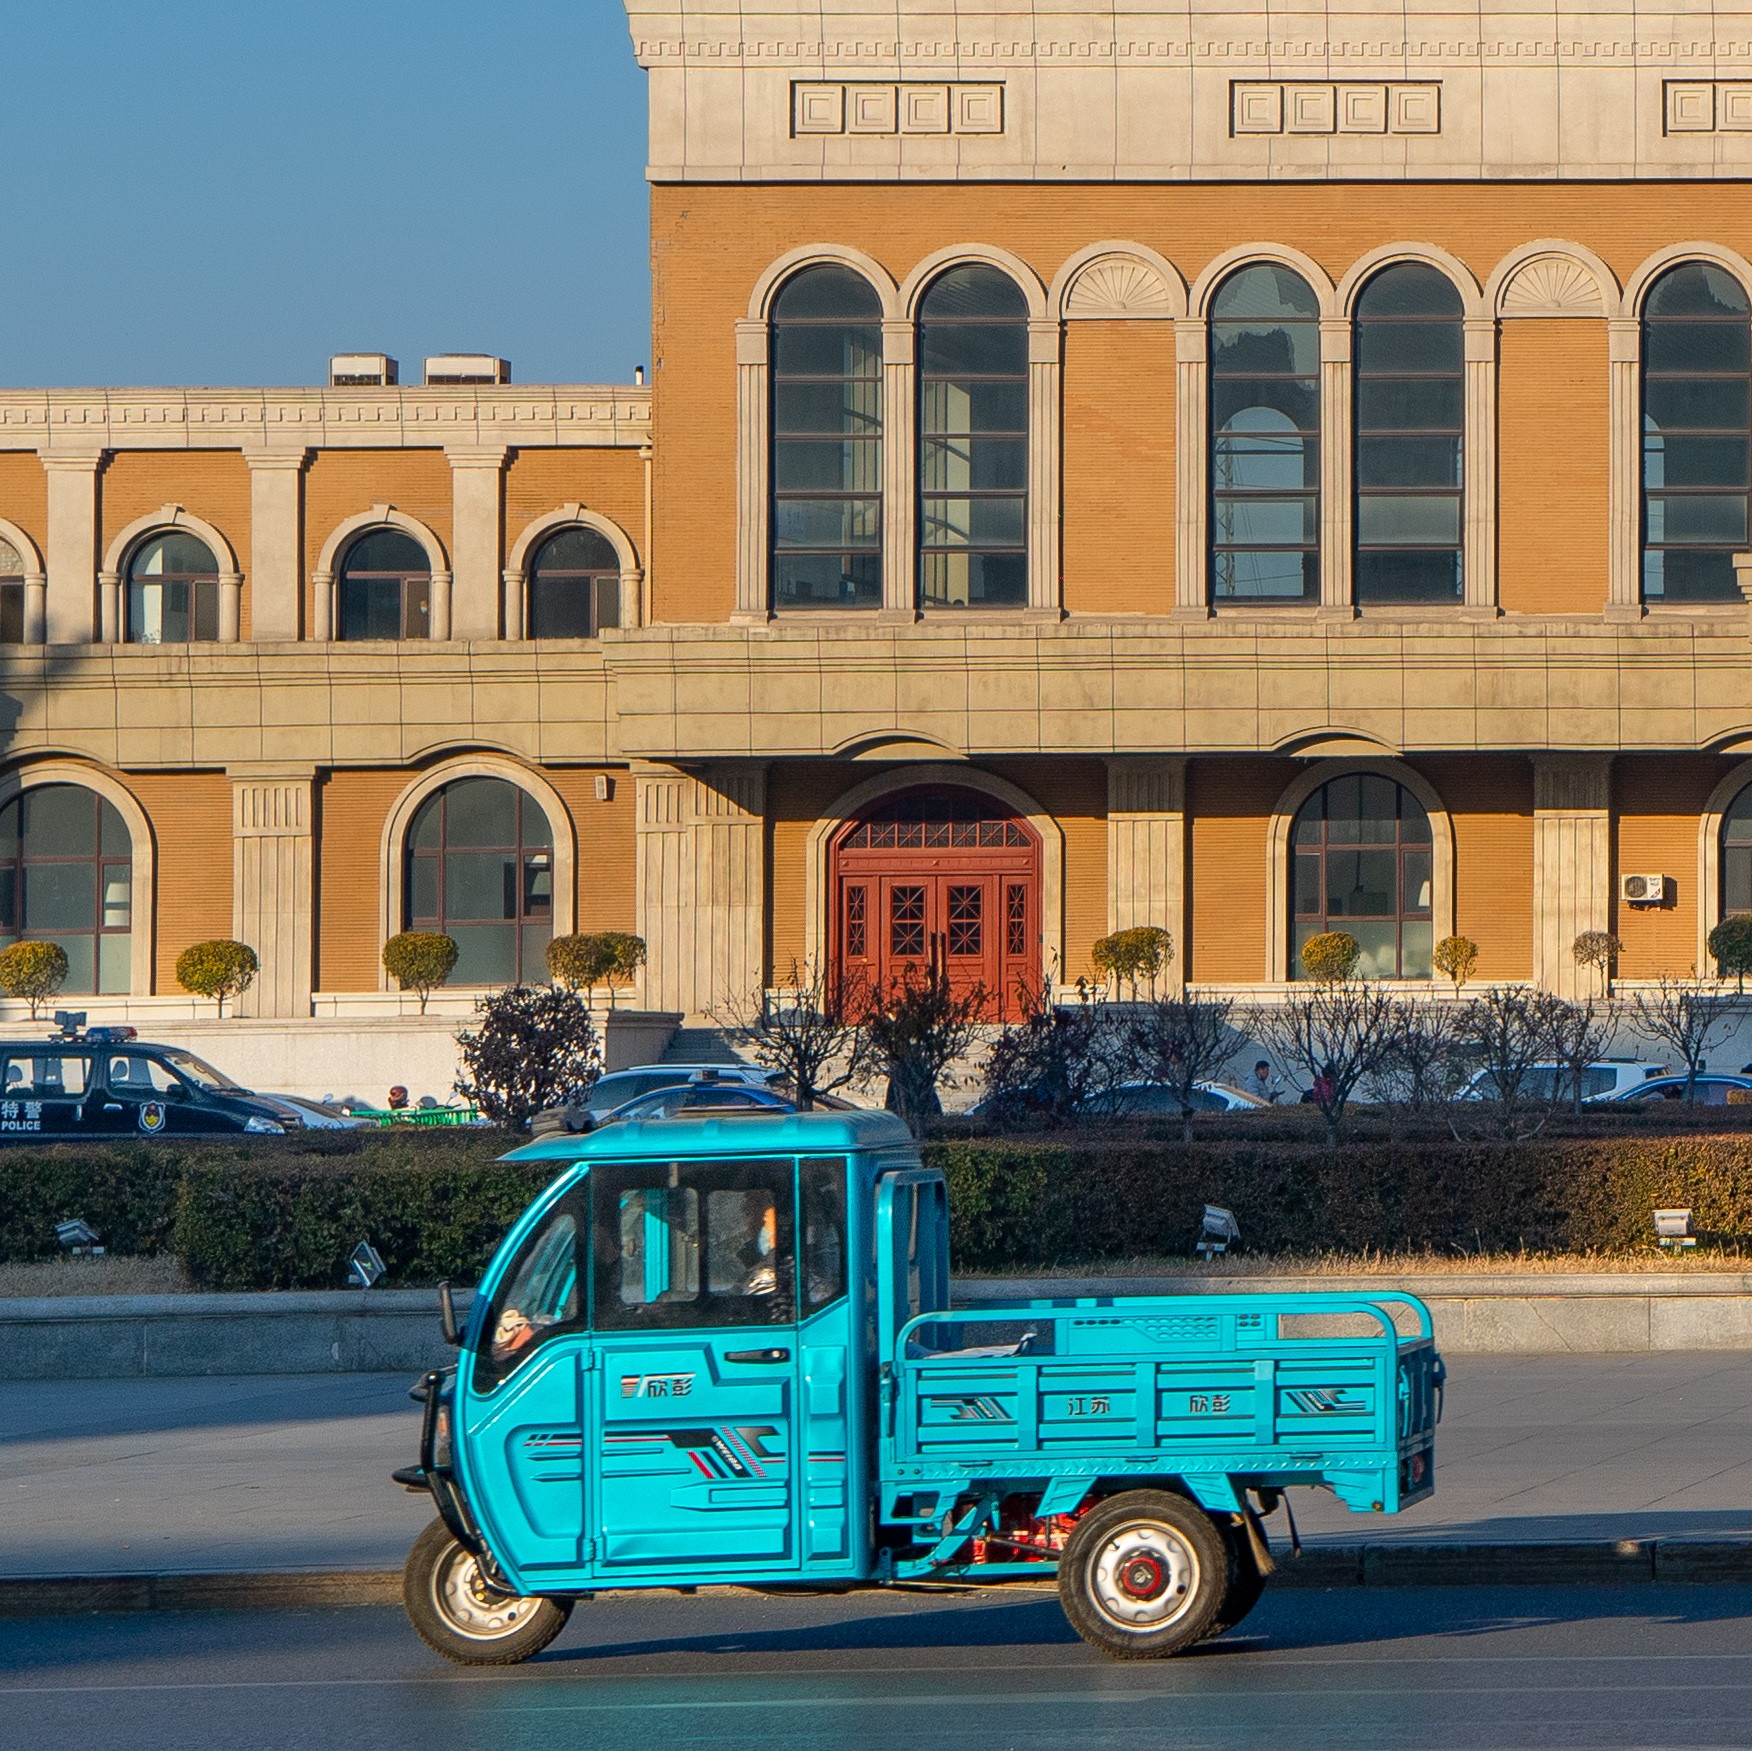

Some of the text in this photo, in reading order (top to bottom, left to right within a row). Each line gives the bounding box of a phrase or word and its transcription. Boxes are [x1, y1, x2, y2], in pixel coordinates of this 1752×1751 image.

[1, 1101, 42, 1118] 特警
[1, 1120, 41, 1131] POLICE
[647, 1378, 693, 1398] 欣彭
[1068, 1393, 1231, 1416] 江苏 欣彭
